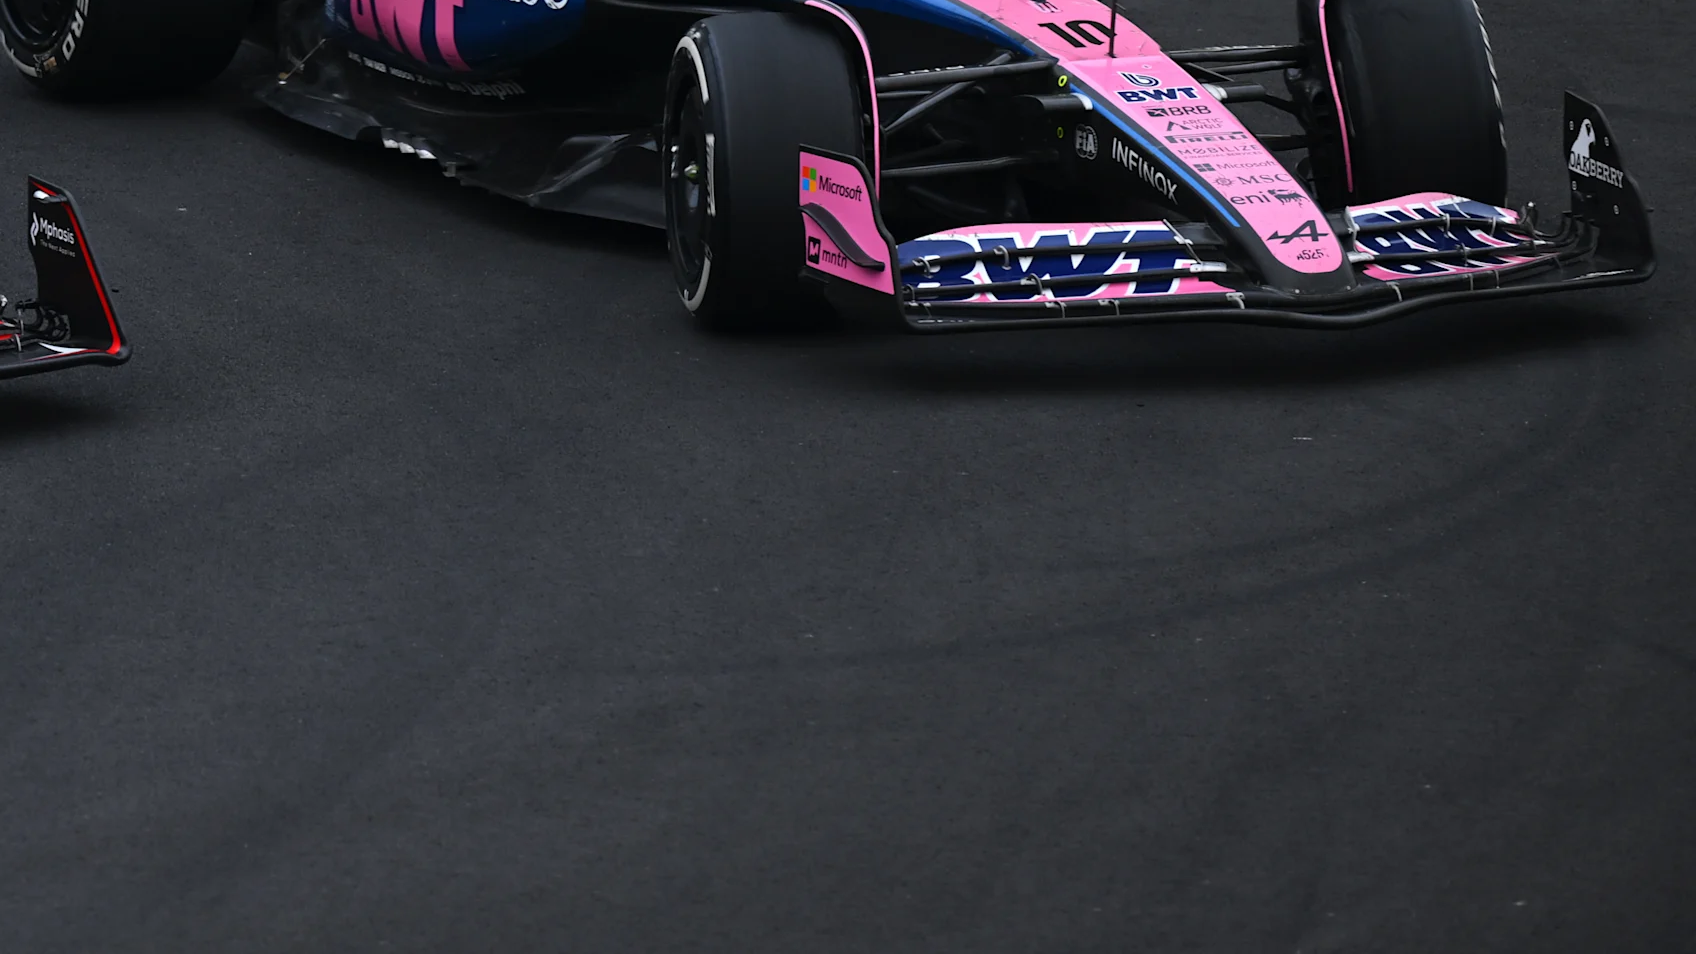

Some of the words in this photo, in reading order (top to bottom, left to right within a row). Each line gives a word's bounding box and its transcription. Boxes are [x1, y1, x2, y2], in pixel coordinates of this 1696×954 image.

[1037, 19, 1117, 49] 10
[1116, 86, 1200, 104] BWT
[1168, 105, 1212, 117] BRB
[1182, 117, 1223, 126] ARCTIC
[1192, 123, 1224, 131] WOLF
[1164, 131, 1249, 144] PIRELLI
[1111, 136, 1178, 206] INFINOX
[1216, 160, 1277, 170] Microsoft
[1236, 173, 1293, 185] MSC
[818, 174, 863, 203] Microsoft
[1230, 191, 1271, 205] eni
[39, 216, 75, 245] Mphasis
[821, 249, 848, 270] mntn
